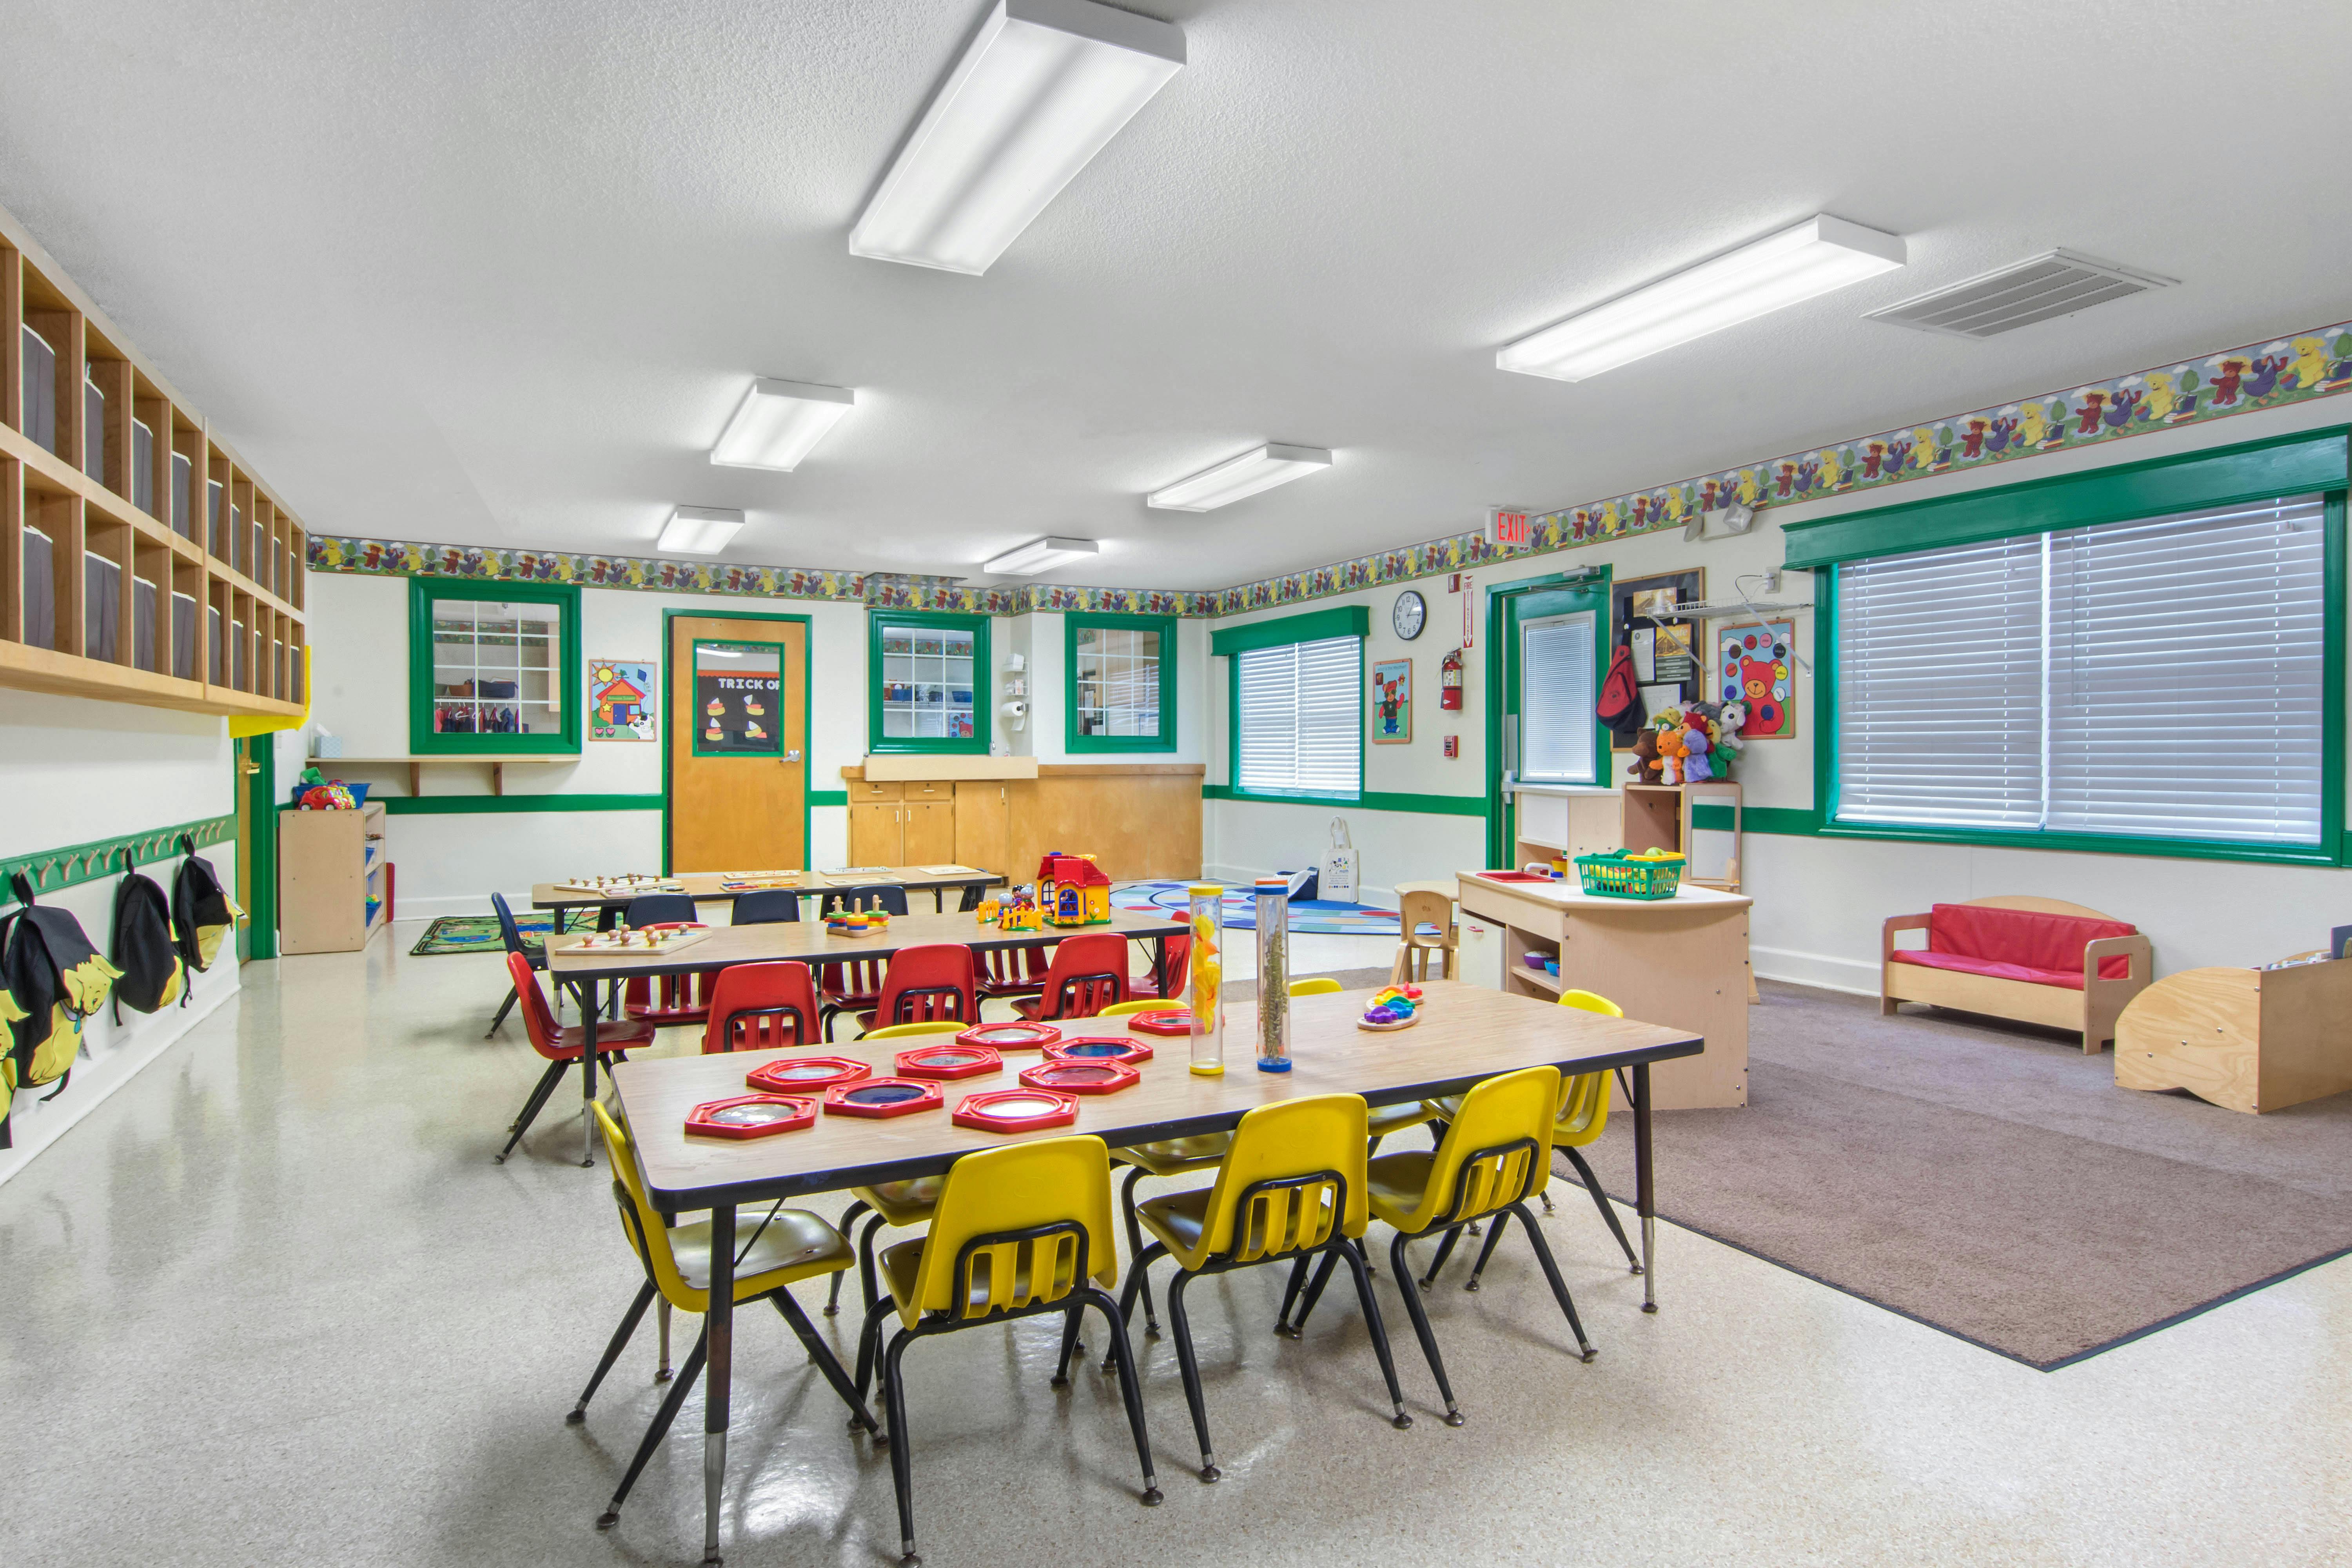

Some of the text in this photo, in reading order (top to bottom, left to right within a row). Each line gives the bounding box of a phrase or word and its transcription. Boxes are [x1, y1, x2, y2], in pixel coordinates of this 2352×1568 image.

[1498, 513, 1526, 543] EXIT
[1464, 582, 1472, 590] FIRE
[718, 678, 764, 690] TRICK
